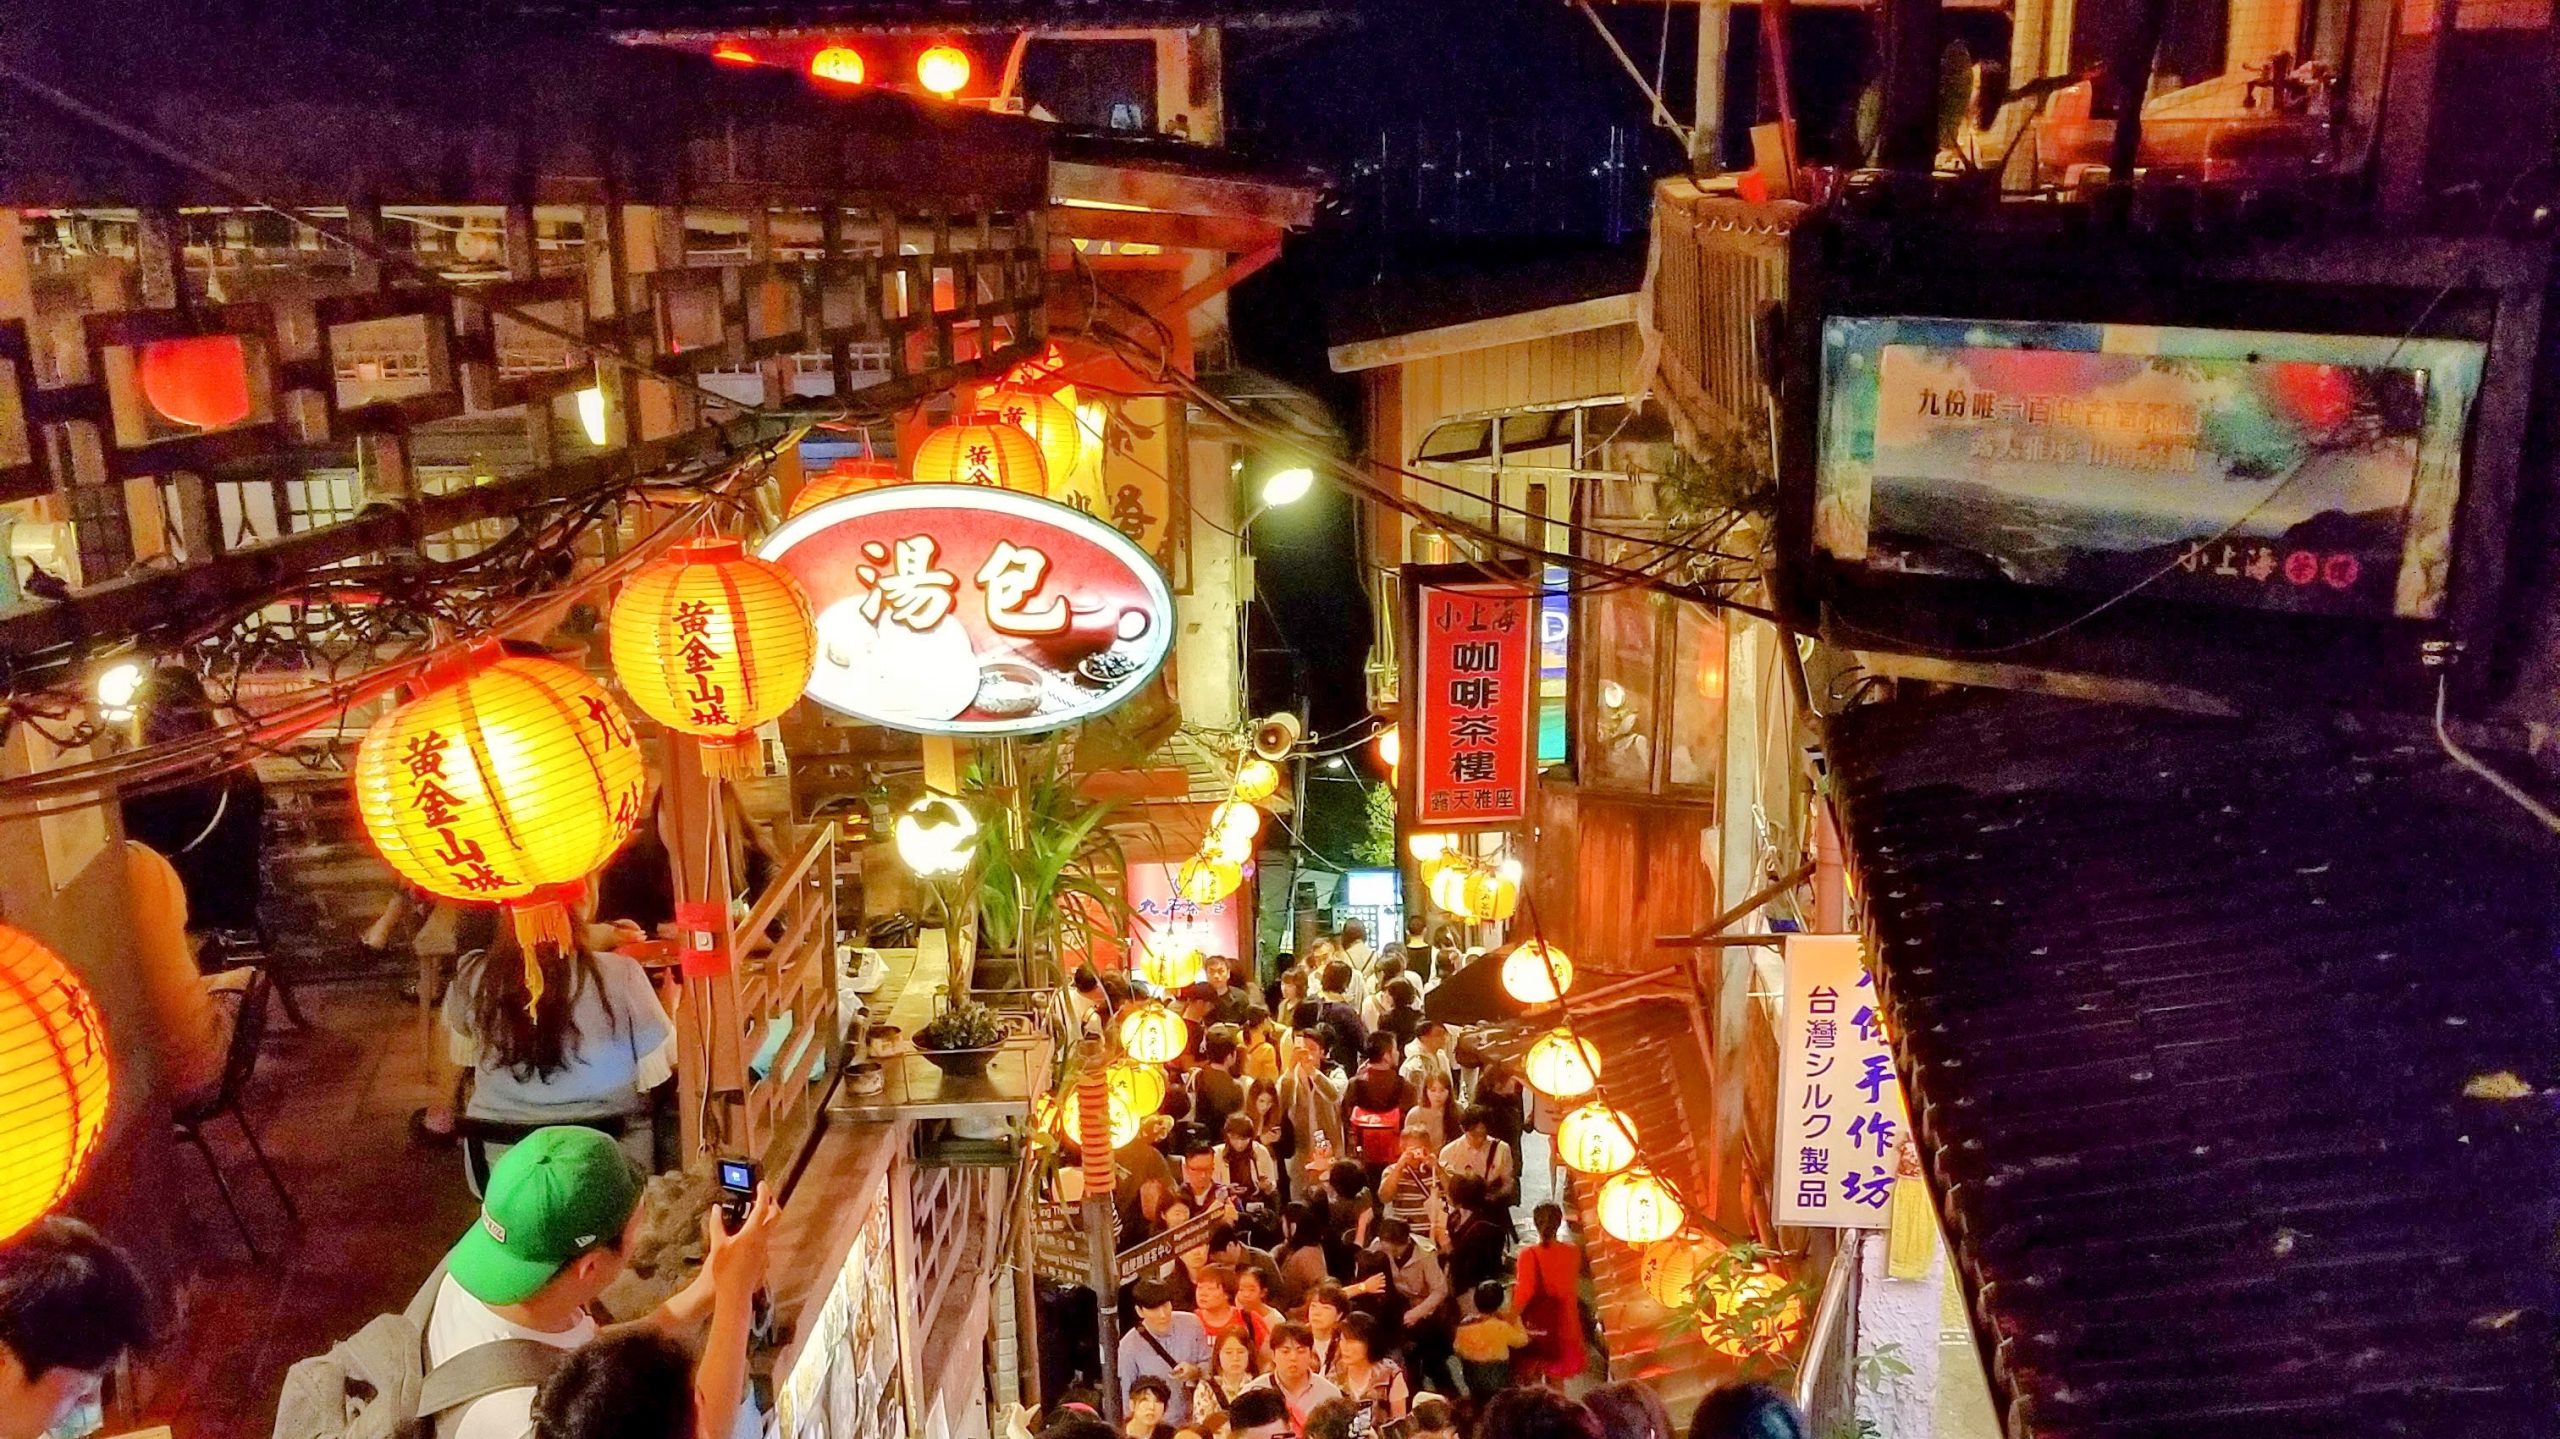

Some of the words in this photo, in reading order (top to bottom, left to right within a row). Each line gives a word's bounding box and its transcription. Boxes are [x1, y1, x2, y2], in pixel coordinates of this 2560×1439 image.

[855, 533, 1073, 638] 湯包
[1436, 600, 1520, 635] 小上海
[1449, 639, 1500, 784] 咖啡茶樓
[1797, 985, 1840, 1208] 台灣シルク製品
